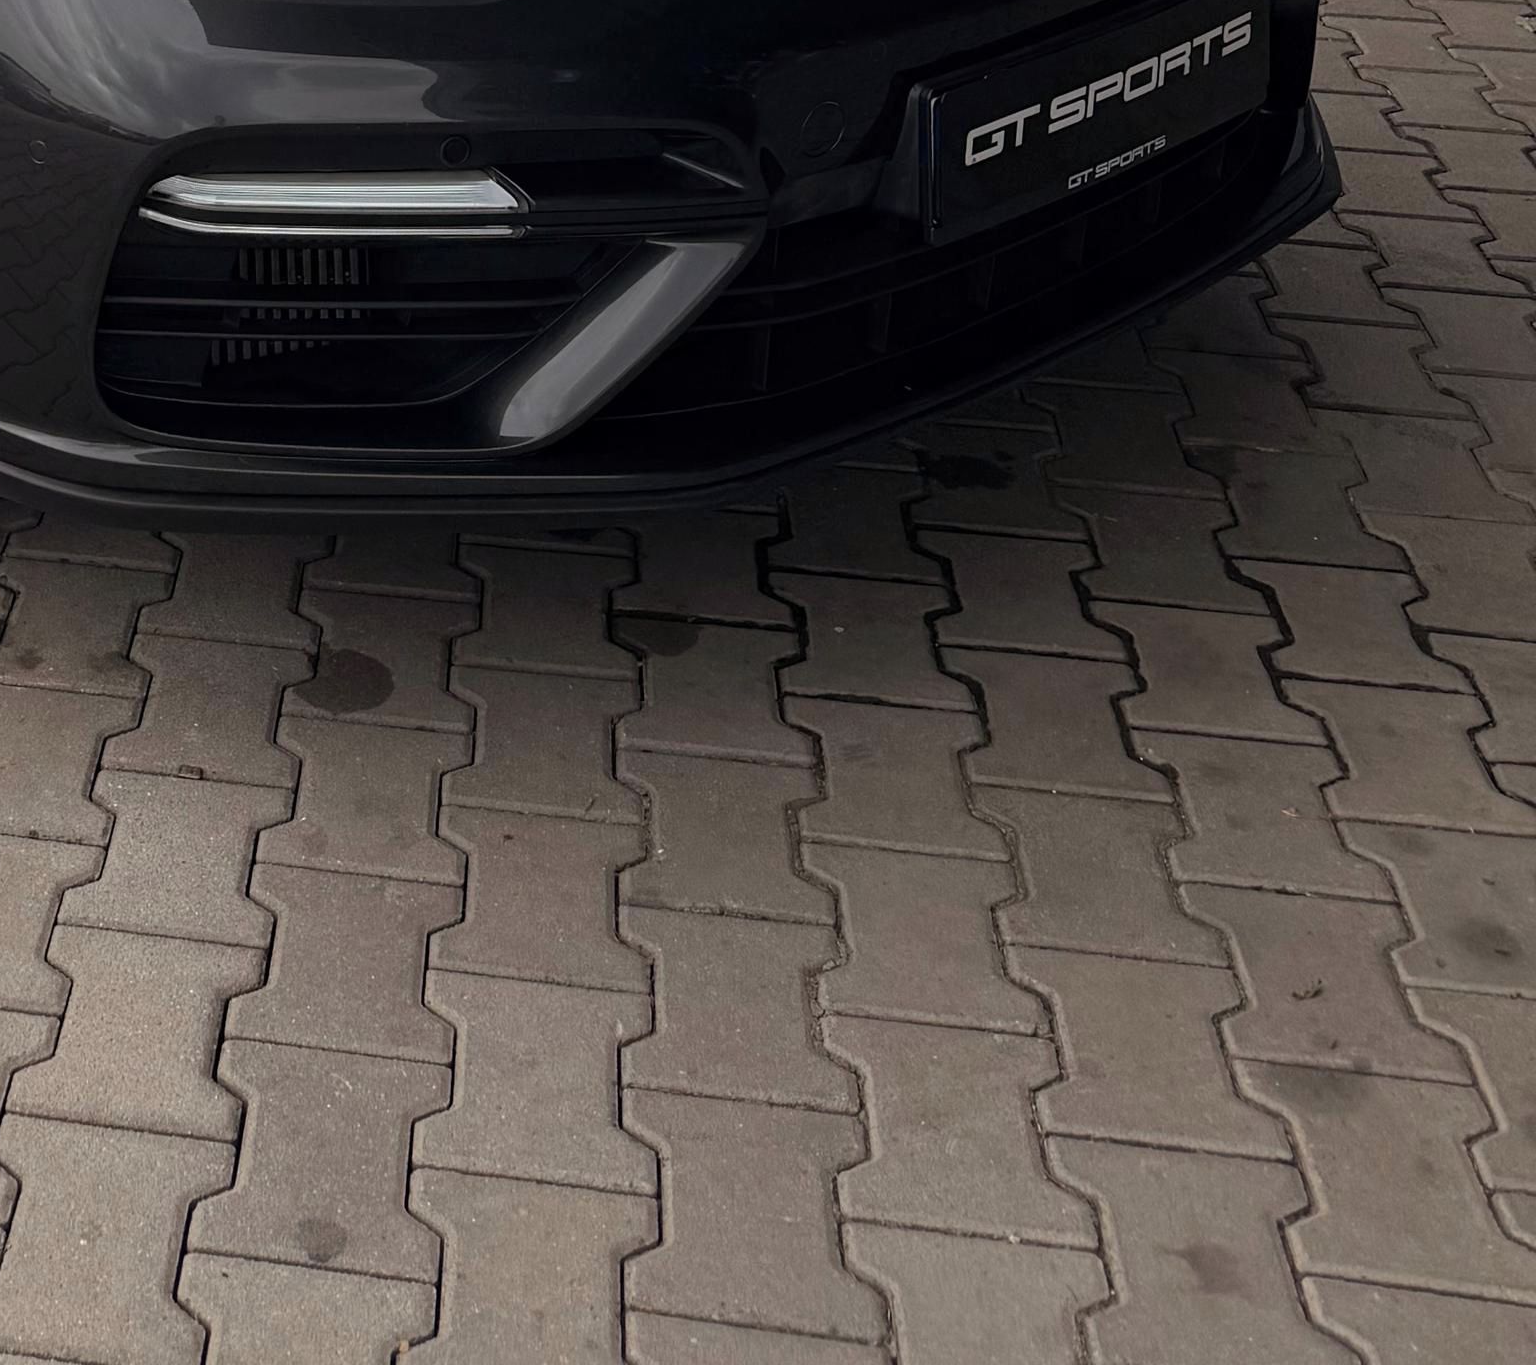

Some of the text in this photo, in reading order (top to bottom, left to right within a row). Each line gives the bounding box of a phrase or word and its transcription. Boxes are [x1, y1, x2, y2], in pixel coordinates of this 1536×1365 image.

[965, 11, 1252, 166] GT SPORTS
[1068, 135, 1167, 189] GT SPORTS
